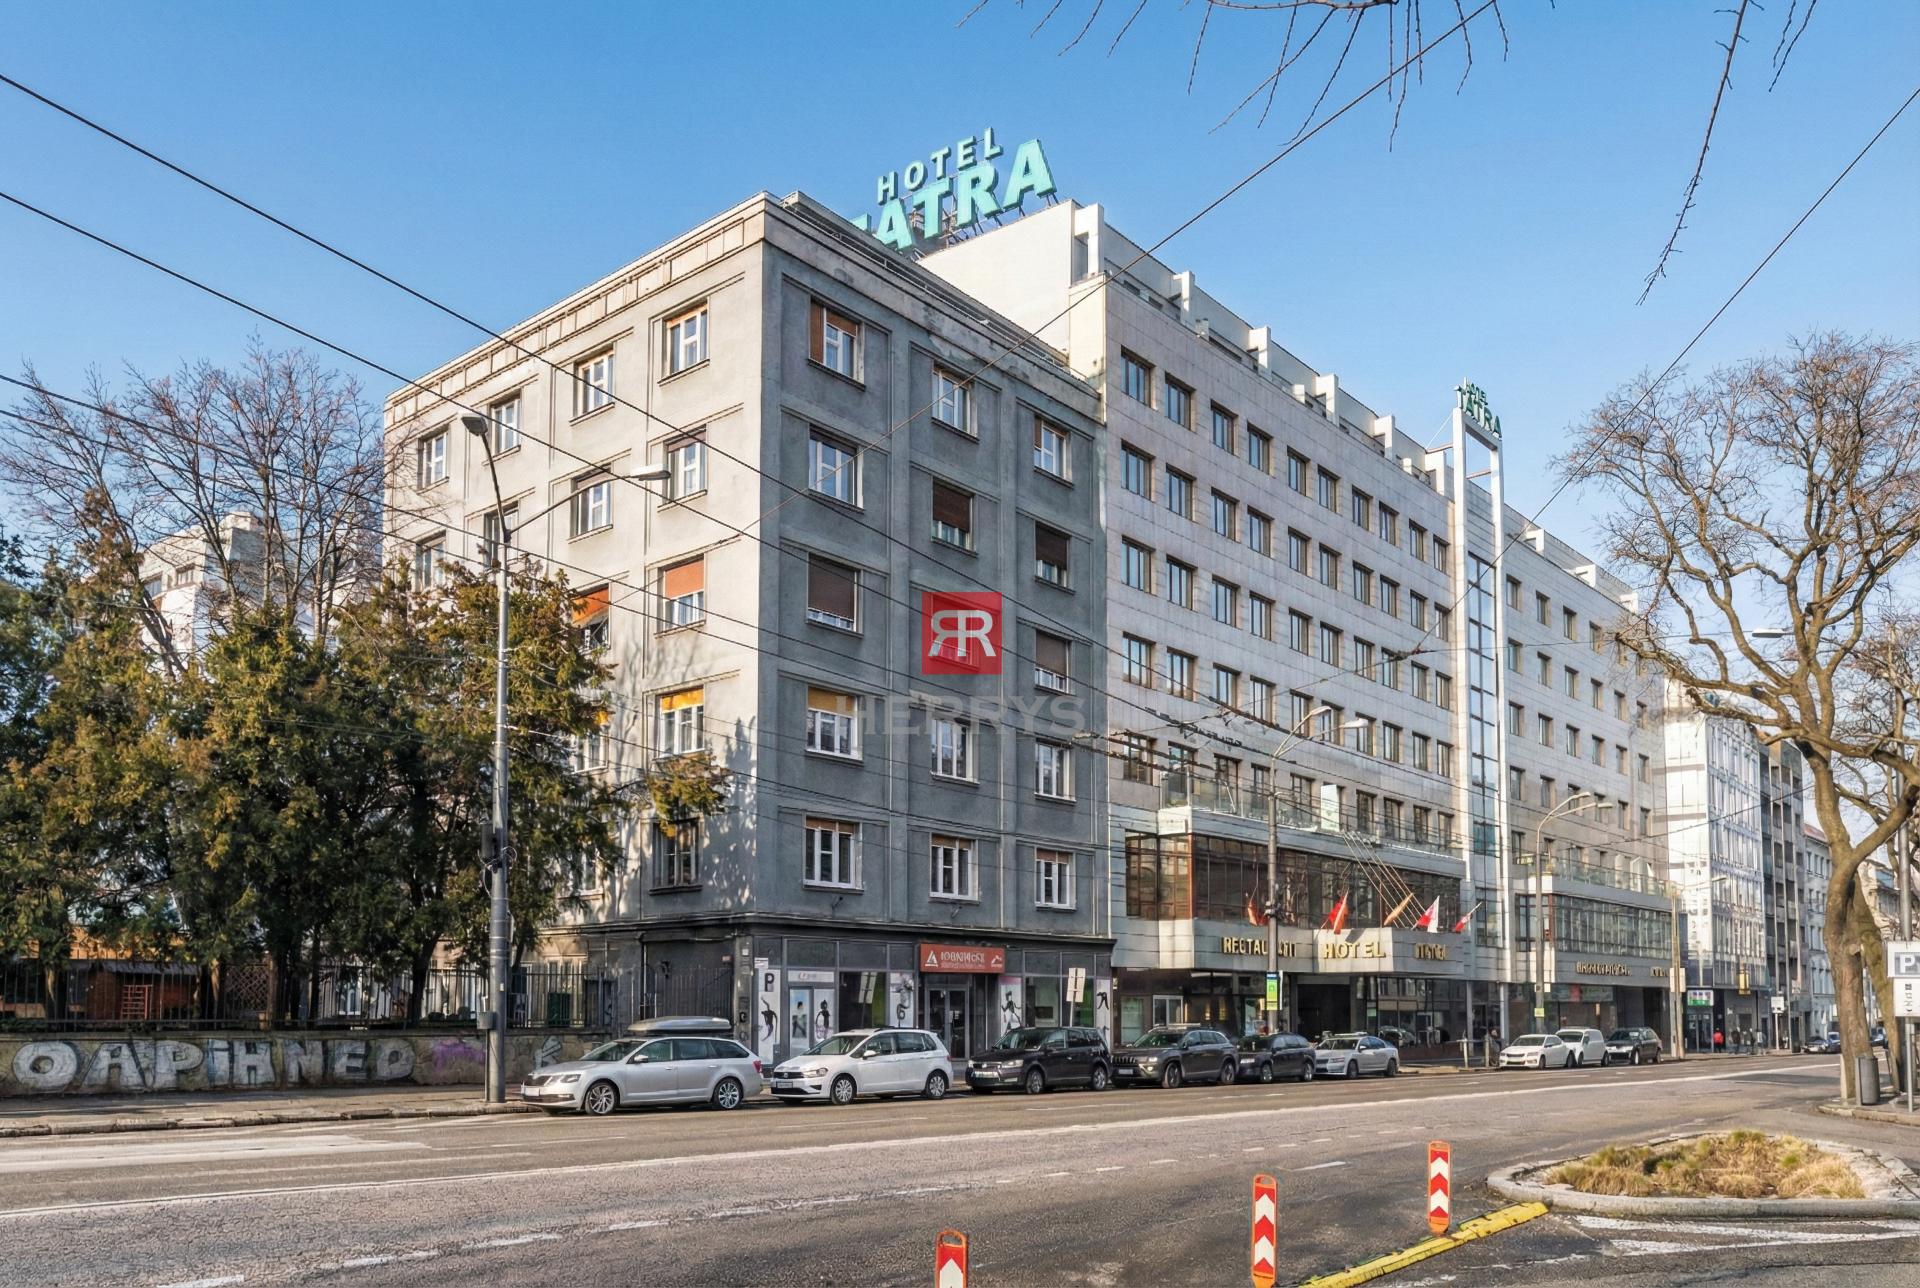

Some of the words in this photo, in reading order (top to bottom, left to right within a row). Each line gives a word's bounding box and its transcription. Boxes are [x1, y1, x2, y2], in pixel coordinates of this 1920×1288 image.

[877, 126, 1004, 206] HOTEL
[1323, 941, 1387, 959] HOTEL
[1899, 954, 1916, 974] P
